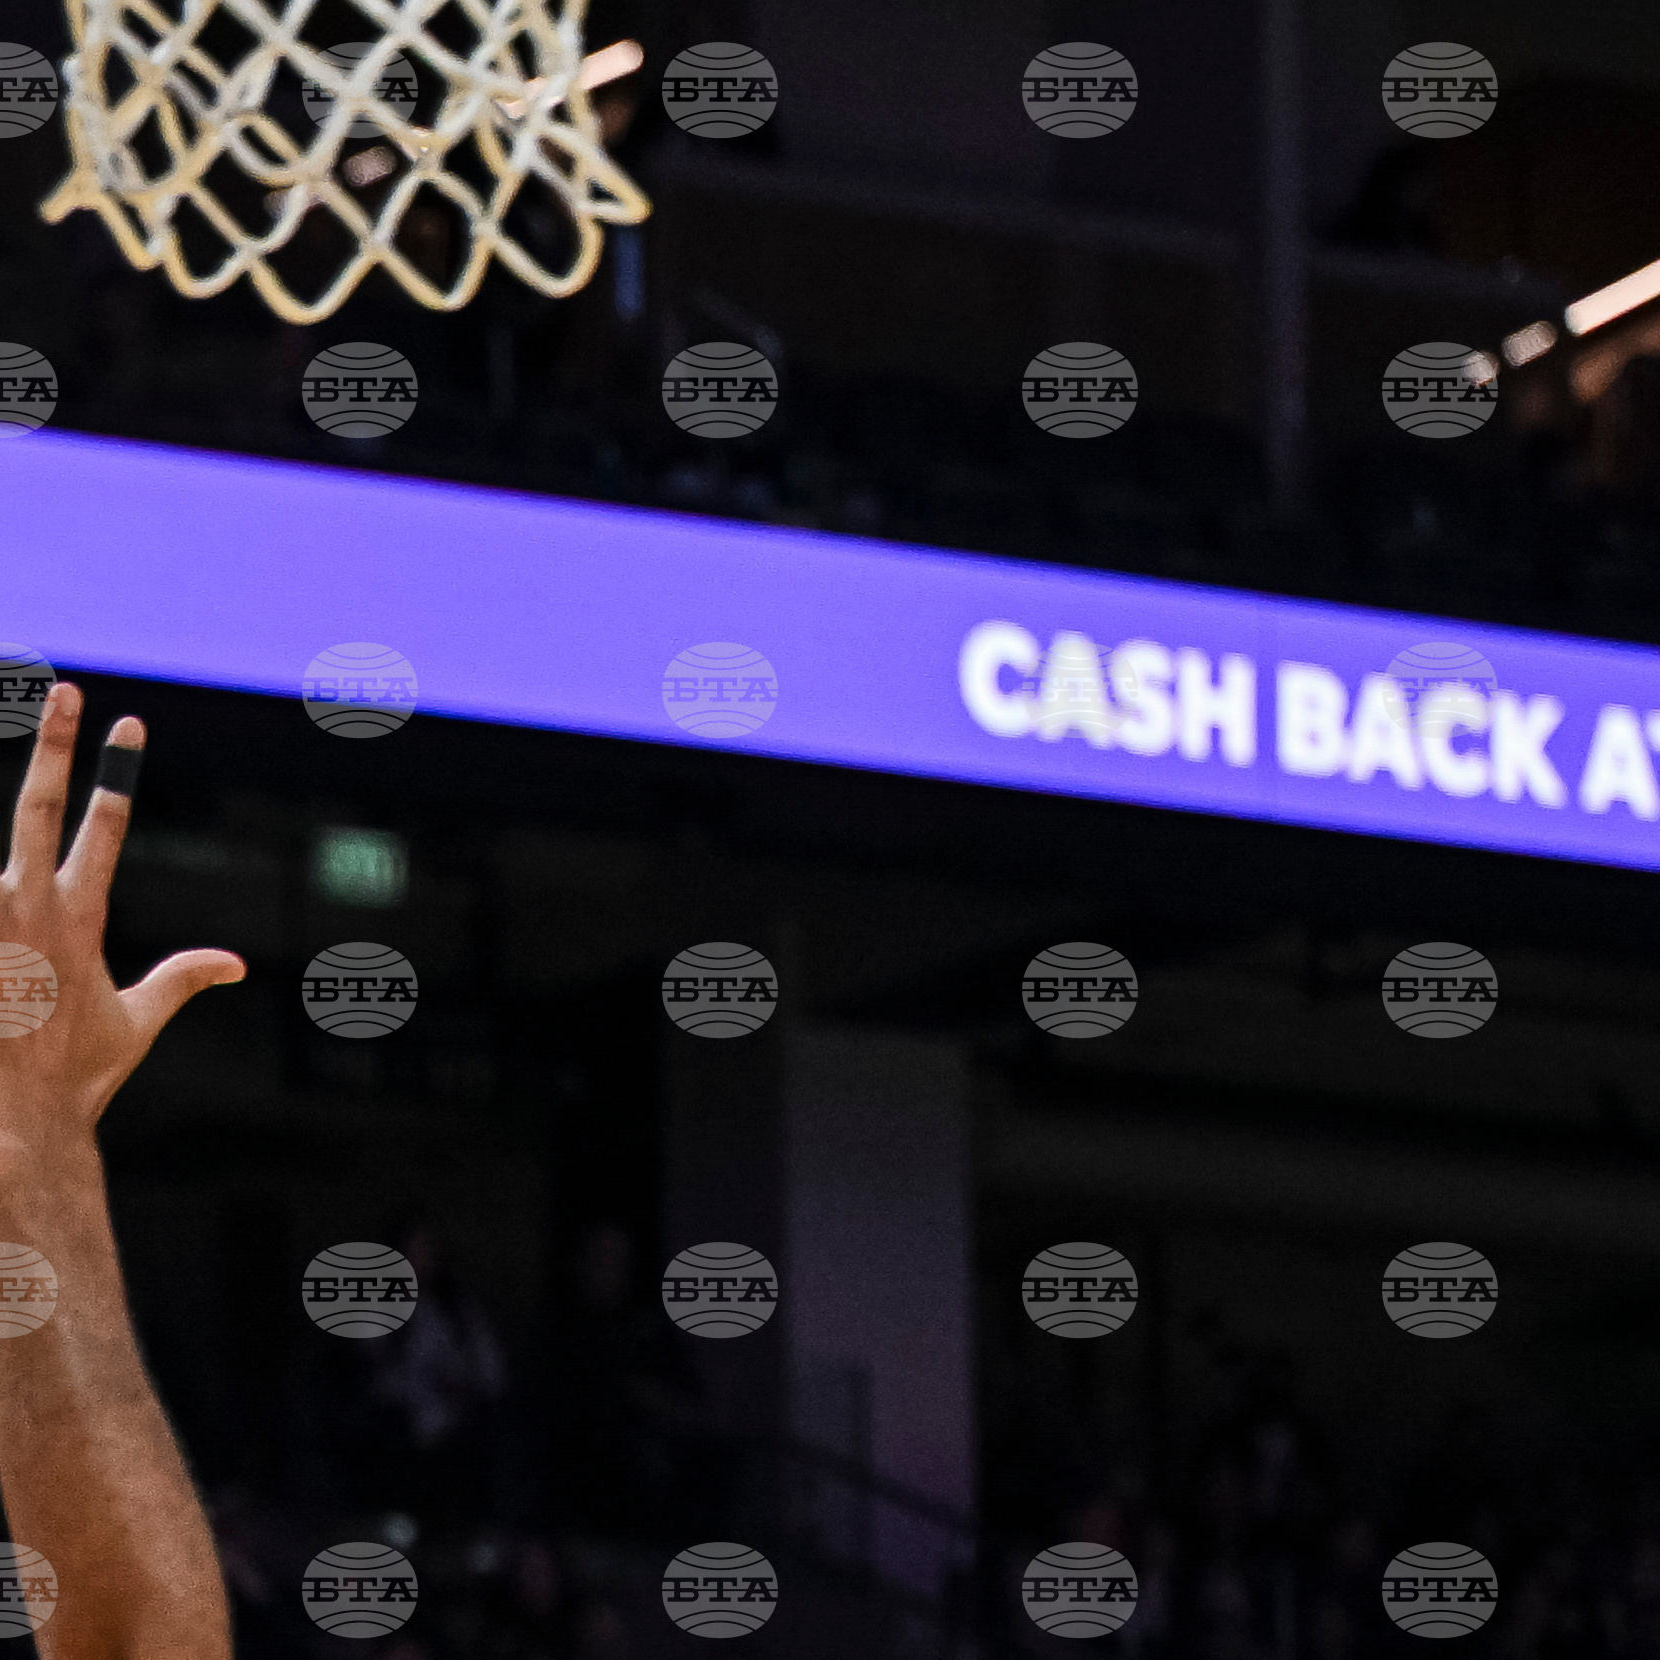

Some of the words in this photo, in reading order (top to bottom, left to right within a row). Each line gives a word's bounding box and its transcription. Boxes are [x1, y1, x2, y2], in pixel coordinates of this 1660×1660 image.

[959, 620, 1256, 768] CASH
[1276, 660, 1568, 809] BACK
[1580, 702, 1660, 822] A
